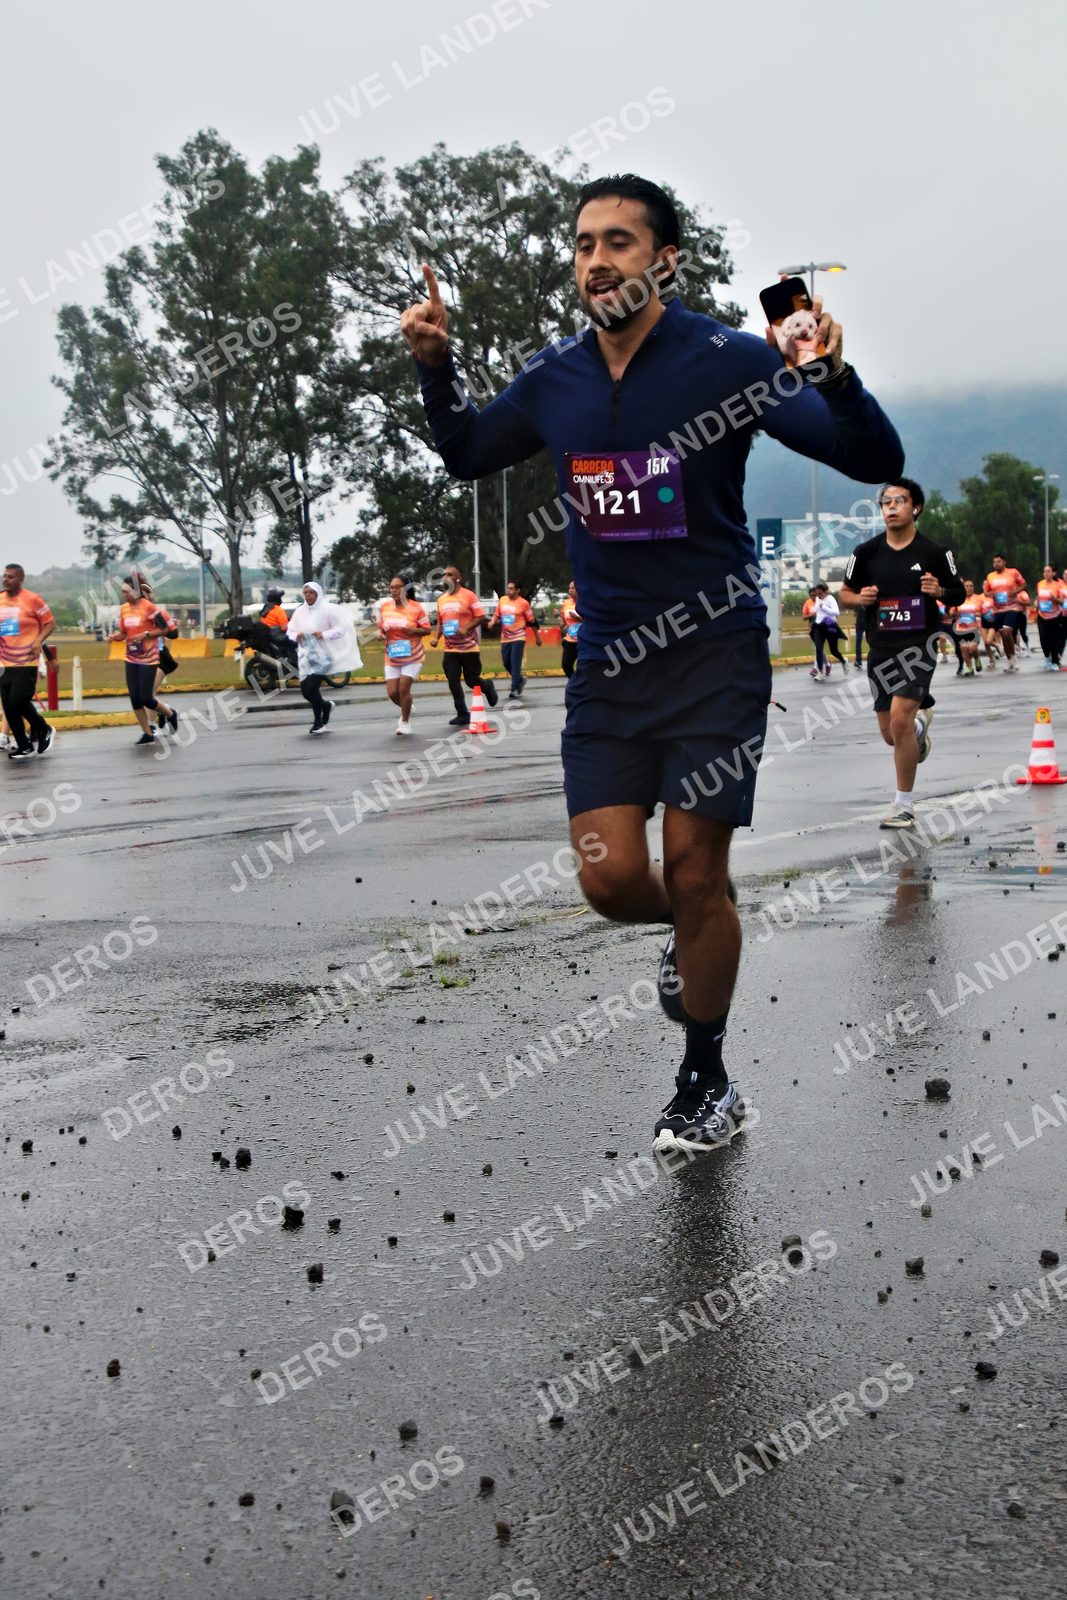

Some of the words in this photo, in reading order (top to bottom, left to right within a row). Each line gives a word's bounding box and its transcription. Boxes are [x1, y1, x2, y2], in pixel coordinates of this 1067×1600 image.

[572, 460, 614, 474] CARRERA
[646, 457, 670, 474] 15K
[573, 474, 604, 484] OMNILIFE
[594, 490, 640, 514] 121
[762, 536, 775, 555] E
[889, 610, 910, 622] 743
